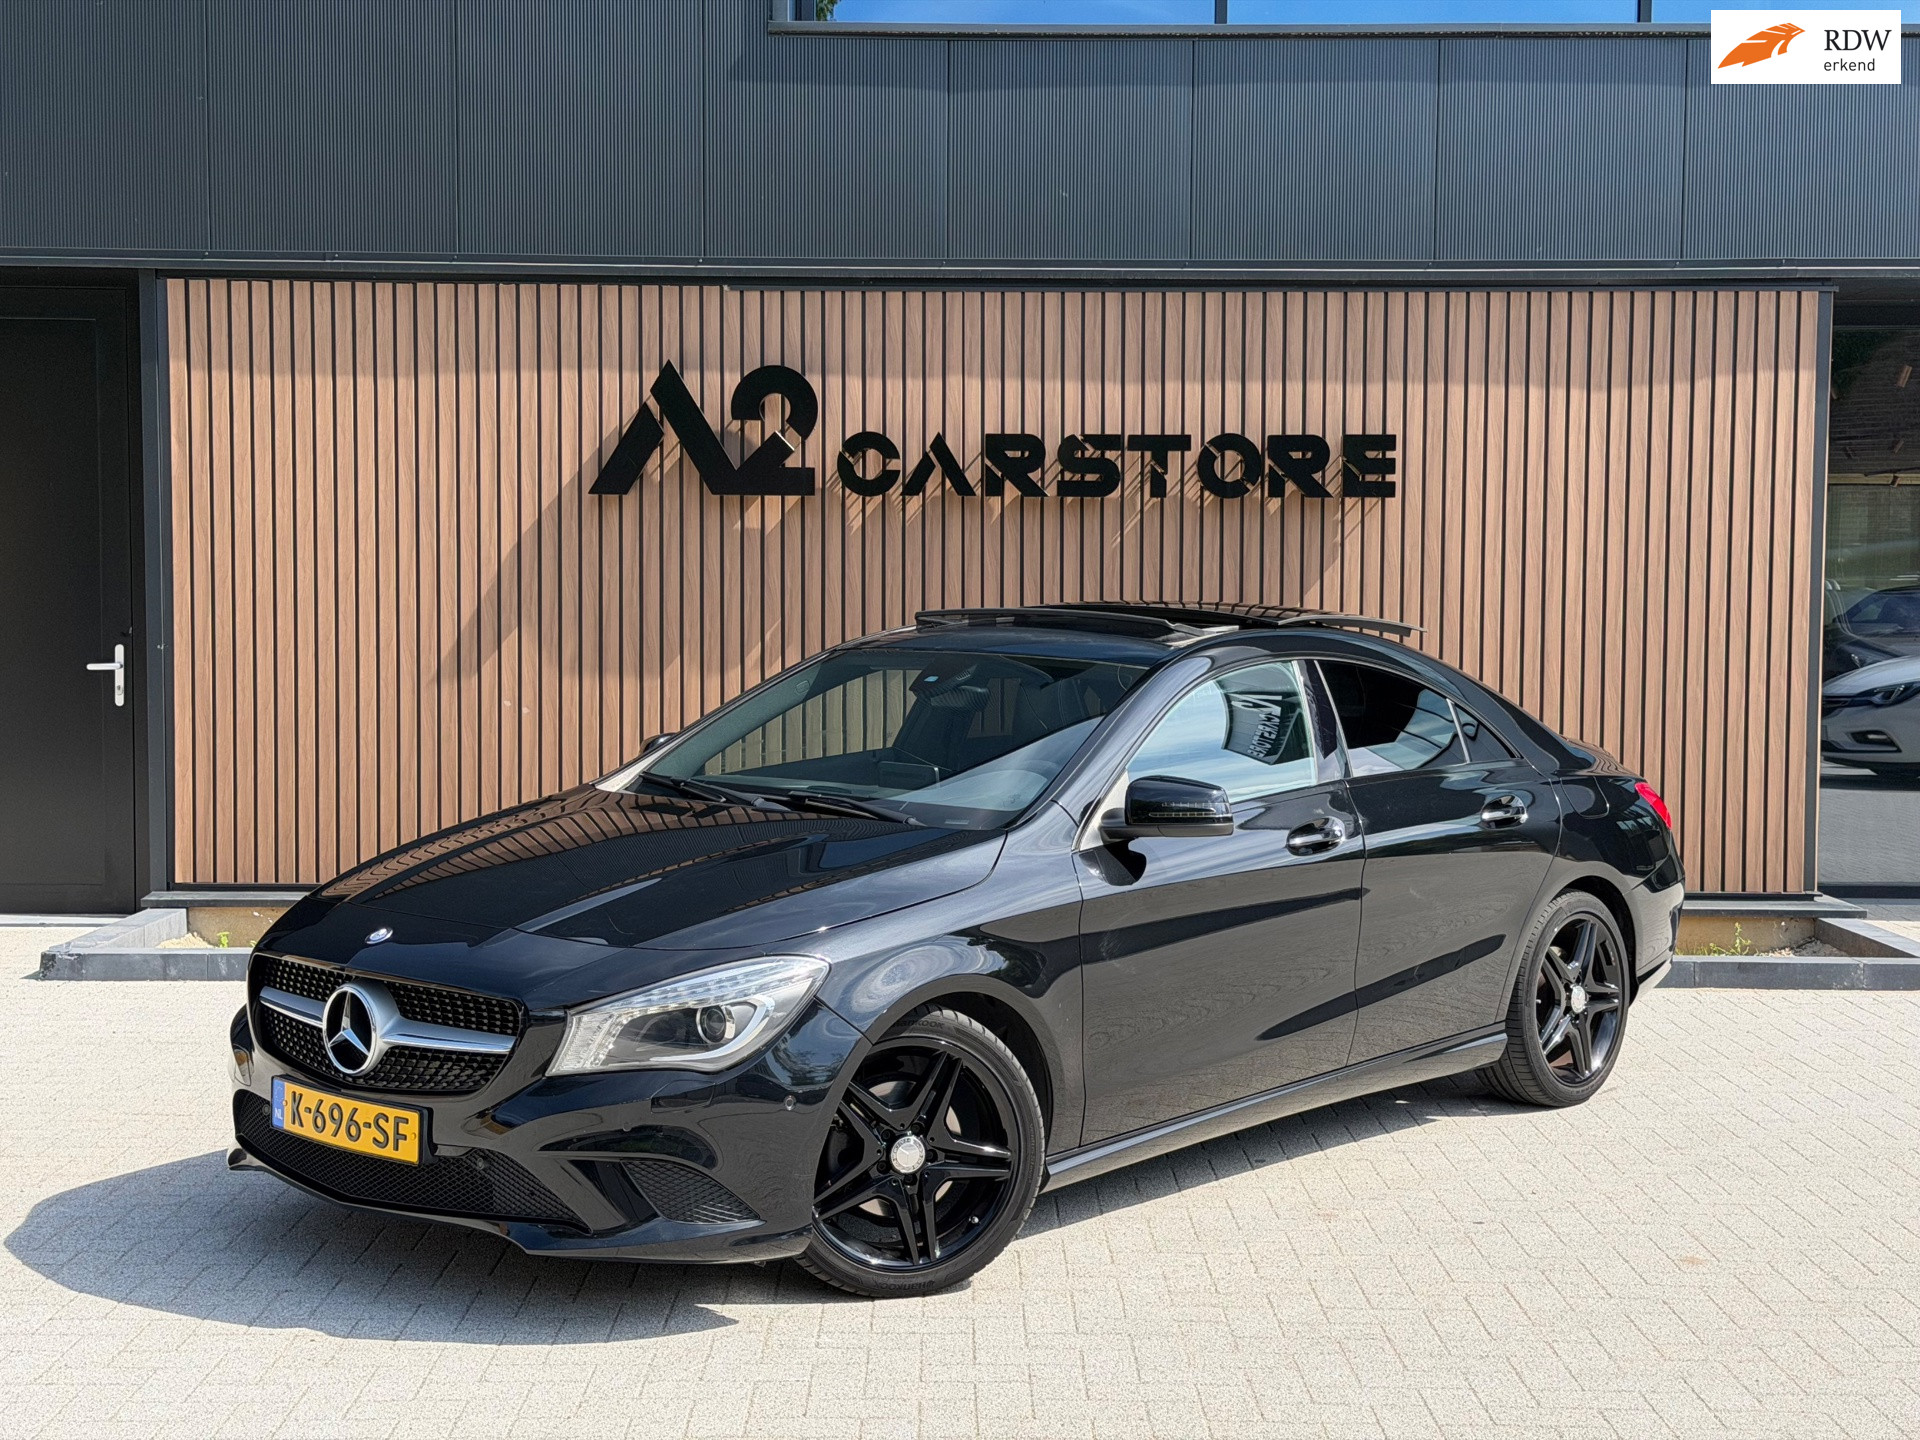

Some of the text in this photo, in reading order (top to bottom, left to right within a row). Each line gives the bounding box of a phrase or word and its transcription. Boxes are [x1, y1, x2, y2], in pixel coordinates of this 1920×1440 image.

[588, 359, 1396, 499] A2 CARSTORE
[274, 1107, 283, 1120] NL
[290, 1090, 409, 1152] K-696-SF
